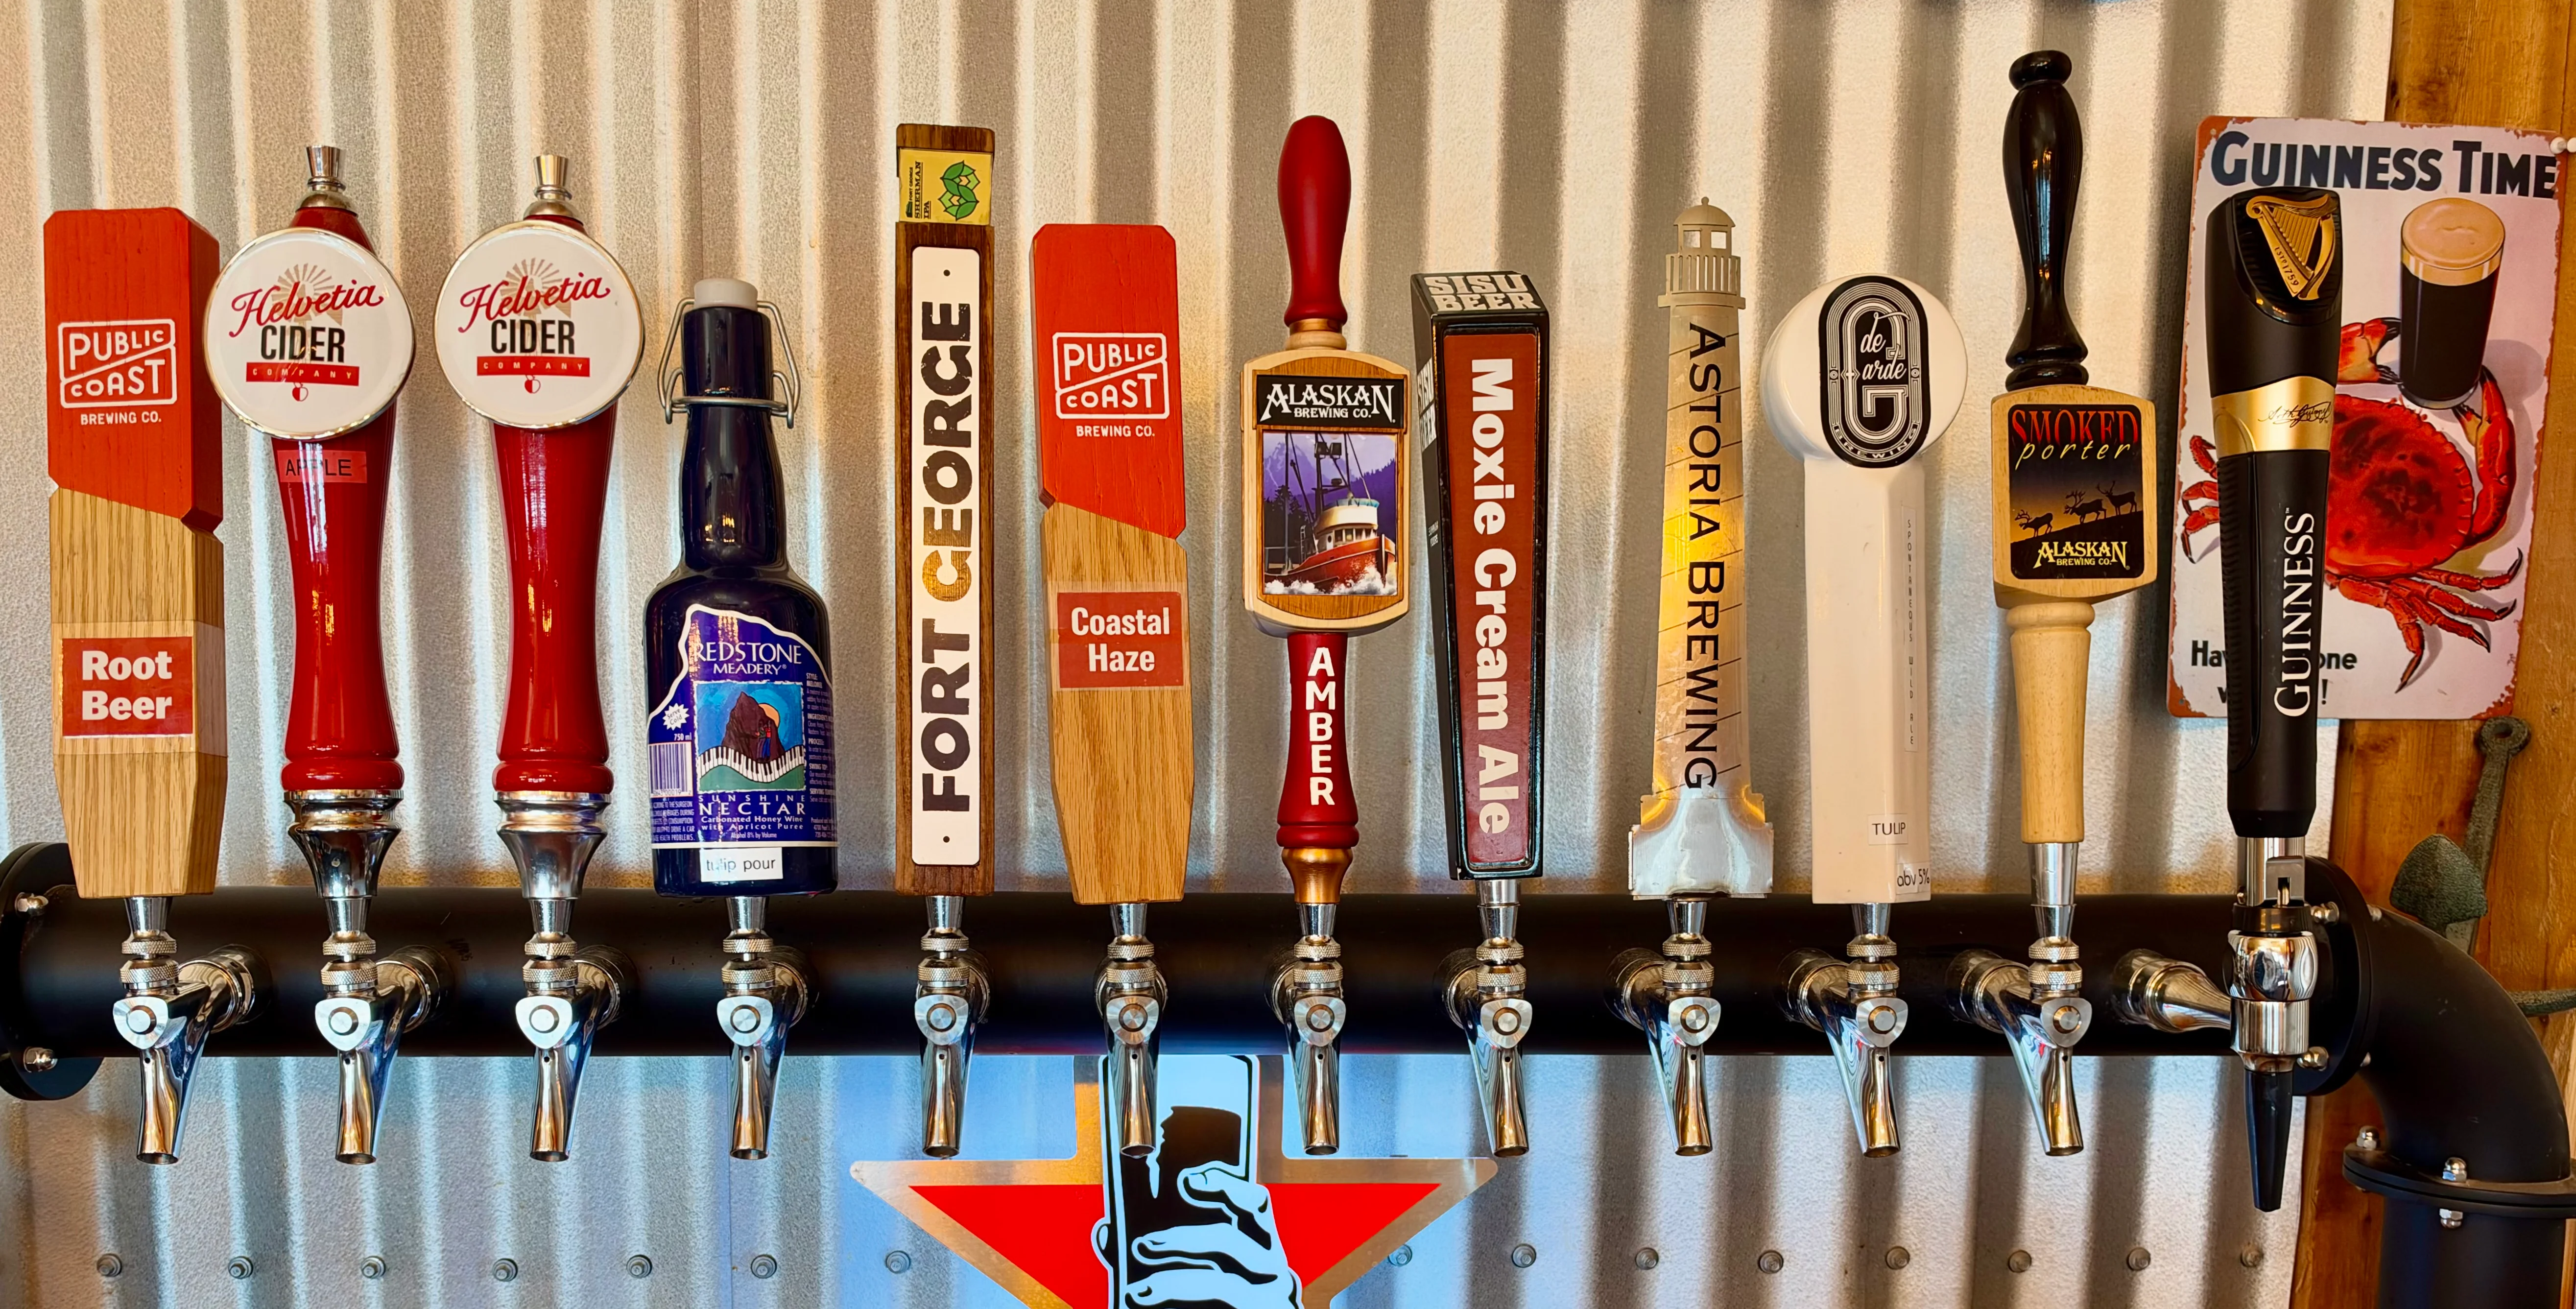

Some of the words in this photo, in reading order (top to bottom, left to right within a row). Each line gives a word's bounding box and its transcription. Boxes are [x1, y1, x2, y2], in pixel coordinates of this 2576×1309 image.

[2211, 131, 2443, 191] GUINNESS
[2453, 140, 2558, 199] TIME
[1424, 274, 1528, 294] SISU
[229, 280, 384, 337] Helvetia
[458, 272, 611, 333] Helvetia
[1431, 293, 1541, 311] BEER
[261, 325, 345, 362] CIDER
[491, 319, 575, 355] CIDER
[1860, 312, 1886, 353] de
[69, 330, 164, 370] PUBLIC
[1064, 343, 1155, 381] PUBLIC
[71, 359, 165, 397] COAST
[252, 368, 352, 379] COMPANY
[483, 362, 583, 371] COMPANY
[1067, 373, 1157, 408] COAST
[1260, 384, 1395, 423] ALASKAN
[80, 412, 137, 425] BREWING
[141, 411, 162, 424] CO.
[1294, 406, 1348, 418] BREWING
[1353, 408, 1371, 418] CO.
[2011, 409, 2139, 445] SMOKED
[1076, 426, 1131, 437] BREWING
[1135, 426, 1155, 437] CO.
[1472, 358, 1516, 535] Moxie
[1688, 322, 1726, 541] ASTORIA
[1835, 426, 1918, 459] BREWING
[920, 301, 973, 602] GEORGE
[2015, 440, 2130, 470] porter
[2033, 541, 2128, 569] ALASKAN
[2056, 557, 2096, 566] BREWING
[1072, 607, 1169, 635] Coastal
[695, 642, 802, 664] REDSTONE
[1474, 548, 1517, 731] Cream
[2192, 640, 2226, 667] Ha
[82, 650, 172, 680] Root
[1088, 643, 1155, 672] Haze
[1684, 561, 1724, 789] BREWING
[82, 690, 172, 720] Beer
[667, 709, 680, 719] Serve
[670, 714, 682, 725] Cold
[921, 618, 970, 811] FORT
[685, 732, 692, 740] ml
[1306, 647, 1336, 806] AMBER
[1479, 743, 1519, 834] Ale
[699, 802, 806, 815] NECTAR
[1872, 822, 1906, 835] TULIP
[743, 859, 776, 872] pour
[1897, 871, 1916, 887] abv
[1918, 868, 1930, 884] 5%
